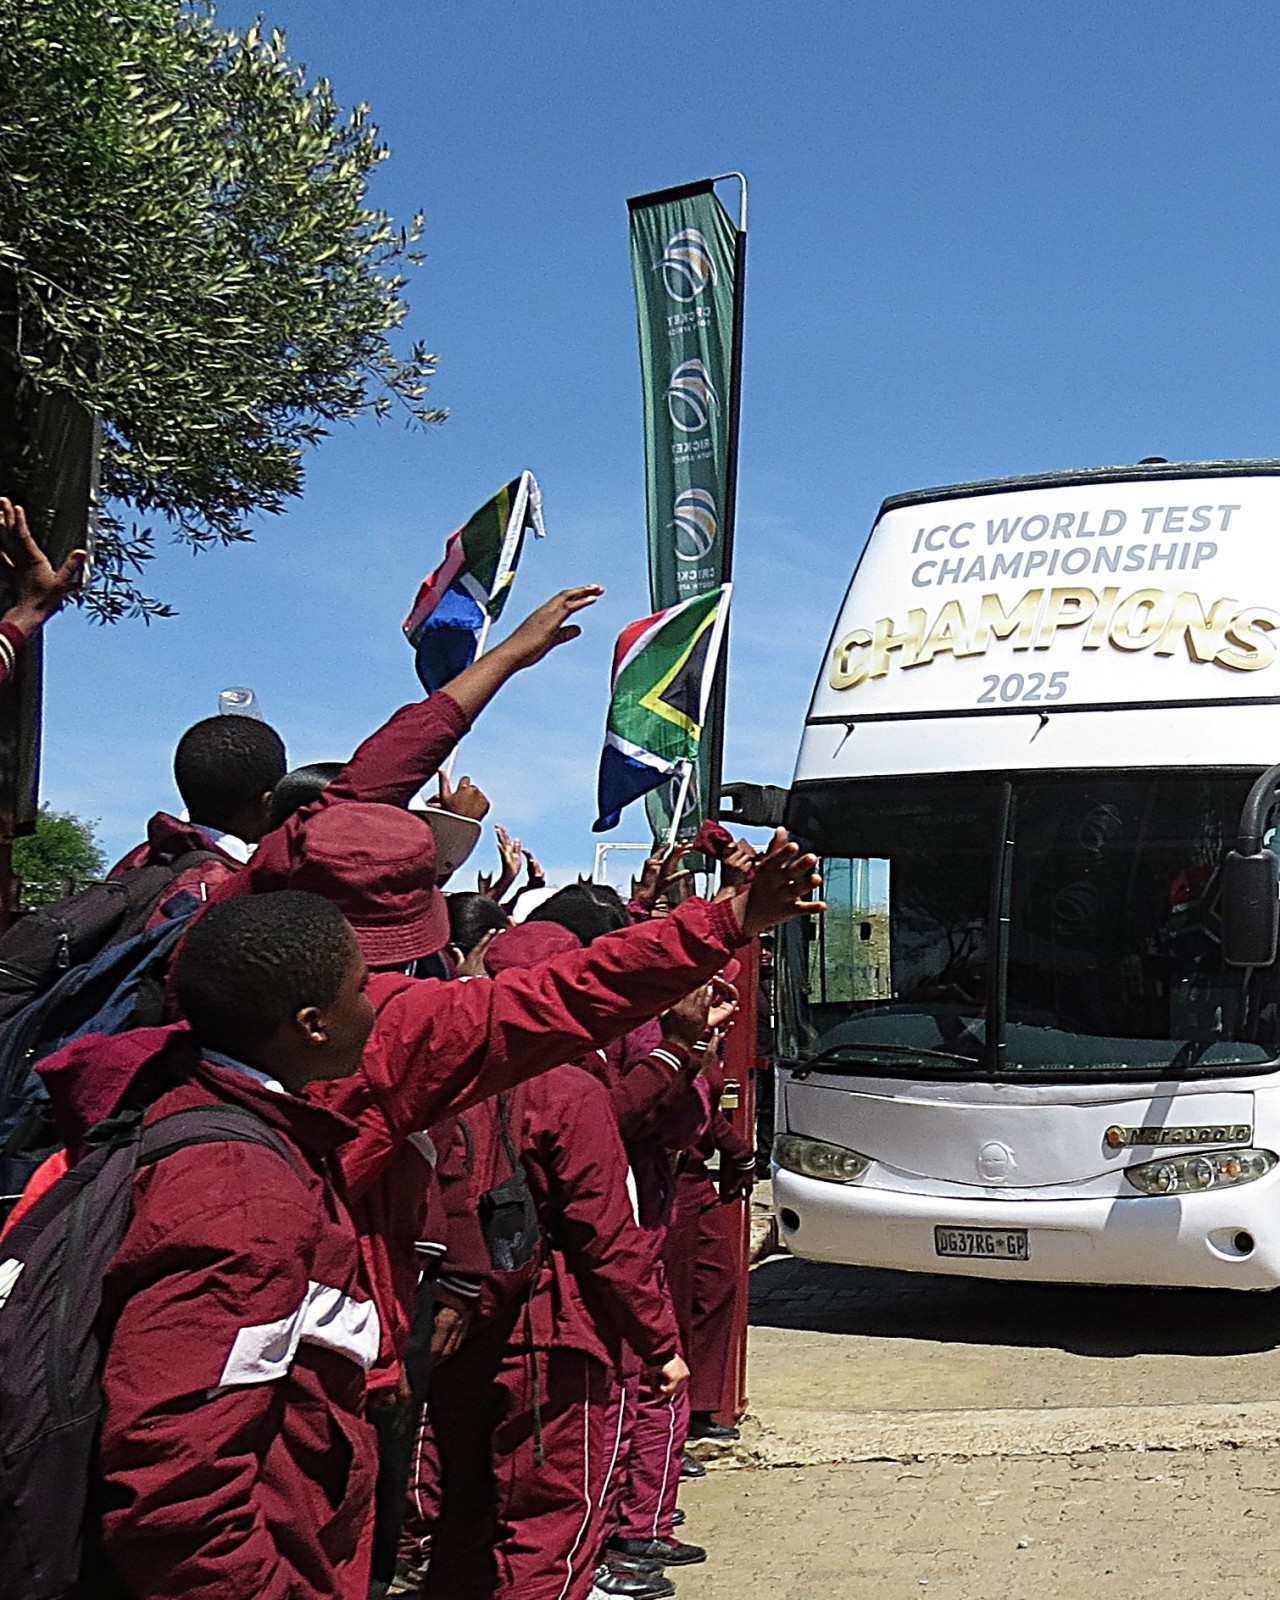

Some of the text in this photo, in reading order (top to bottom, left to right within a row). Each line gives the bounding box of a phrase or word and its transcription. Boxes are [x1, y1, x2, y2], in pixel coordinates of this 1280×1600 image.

[911, 504, 1242, 553] ICC WORLD TEST
[911, 541, 1218, 588] CHAMPIONSHIP
[976, 671, 1069, 703] 2025
[1007, 1235, 1025, 1255] GP
